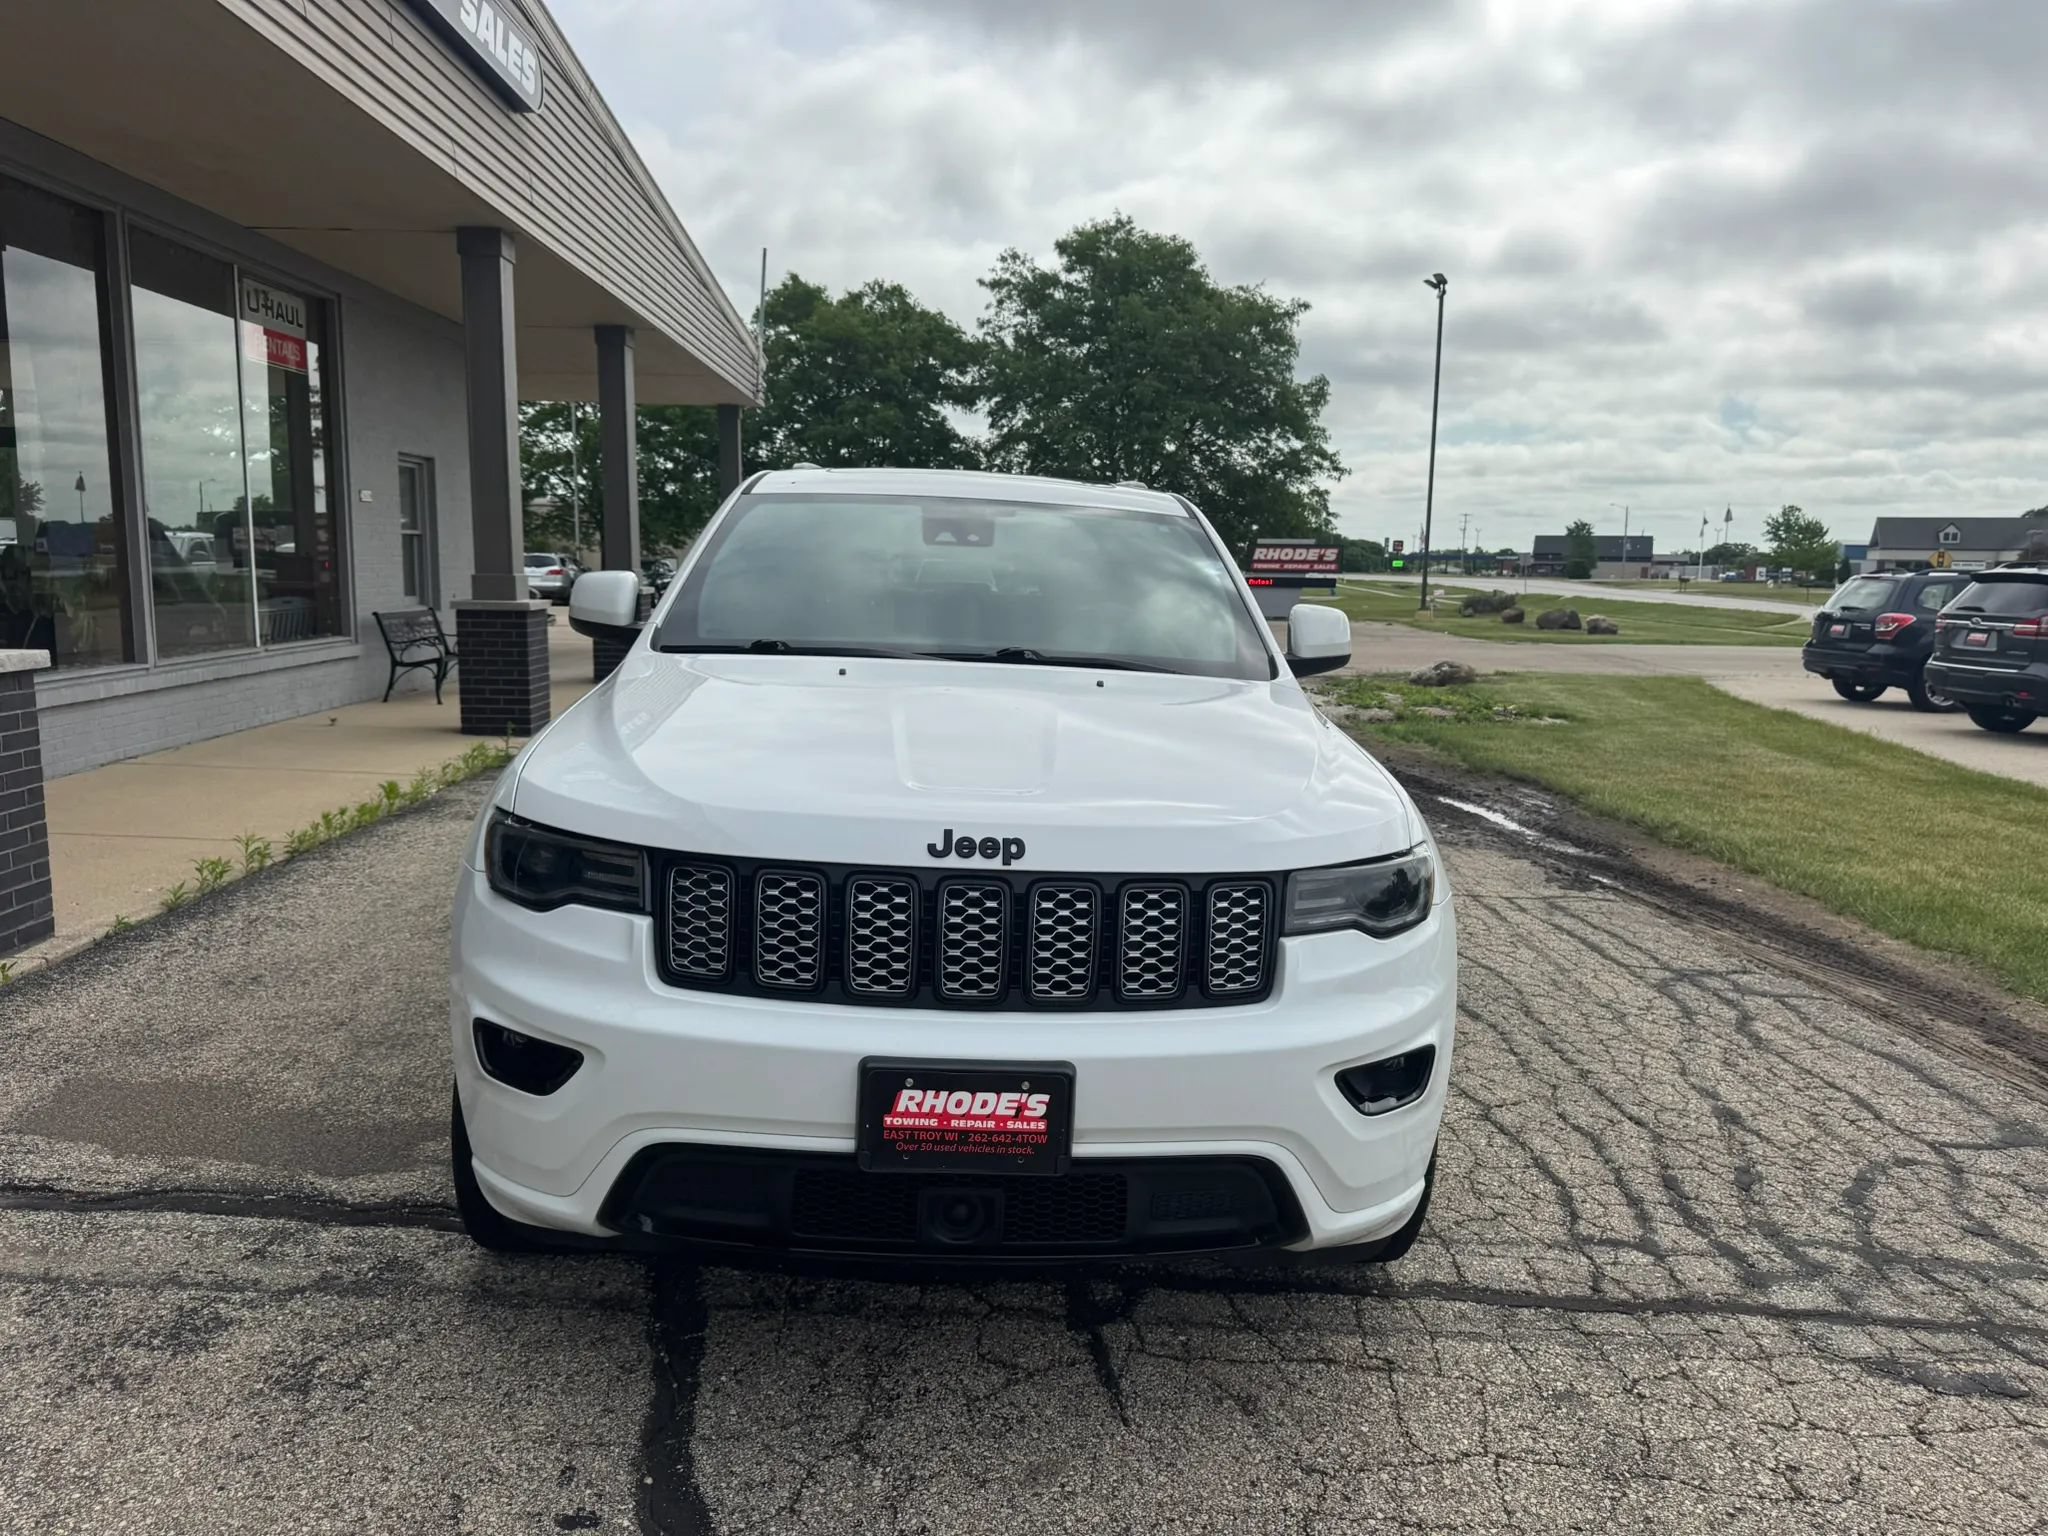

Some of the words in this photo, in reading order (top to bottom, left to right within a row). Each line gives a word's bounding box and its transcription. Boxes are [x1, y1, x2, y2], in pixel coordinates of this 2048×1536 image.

[460, 0, 536, 95] SALES
[1252, 547, 1338, 561] RHODE'S
[927, 828, 1026, 866] Jeep
[896, 1089, 1051, 1117] RHODE'S
[884, 1117, 938, 1127] TOWING
[950, 1119, 996, 1129] REPAIR
[1006, 1121, 1046, 1130] SALES
[883, 1129, 911, 1140] EAST
[912, 1131, 942, 1141] TROY
[944, 1132, 958, 1141] WI
[968, 1133, 1048, 1144] 262-642-4TOW
[896, 1142, 918, 1151] Over
[920, 1142, 932, 1151] 50
[934, 1143, 957, 1152] used
[958, 1144, 994, 1154] vehicles
[996, 1145, 1006, 1154] in
